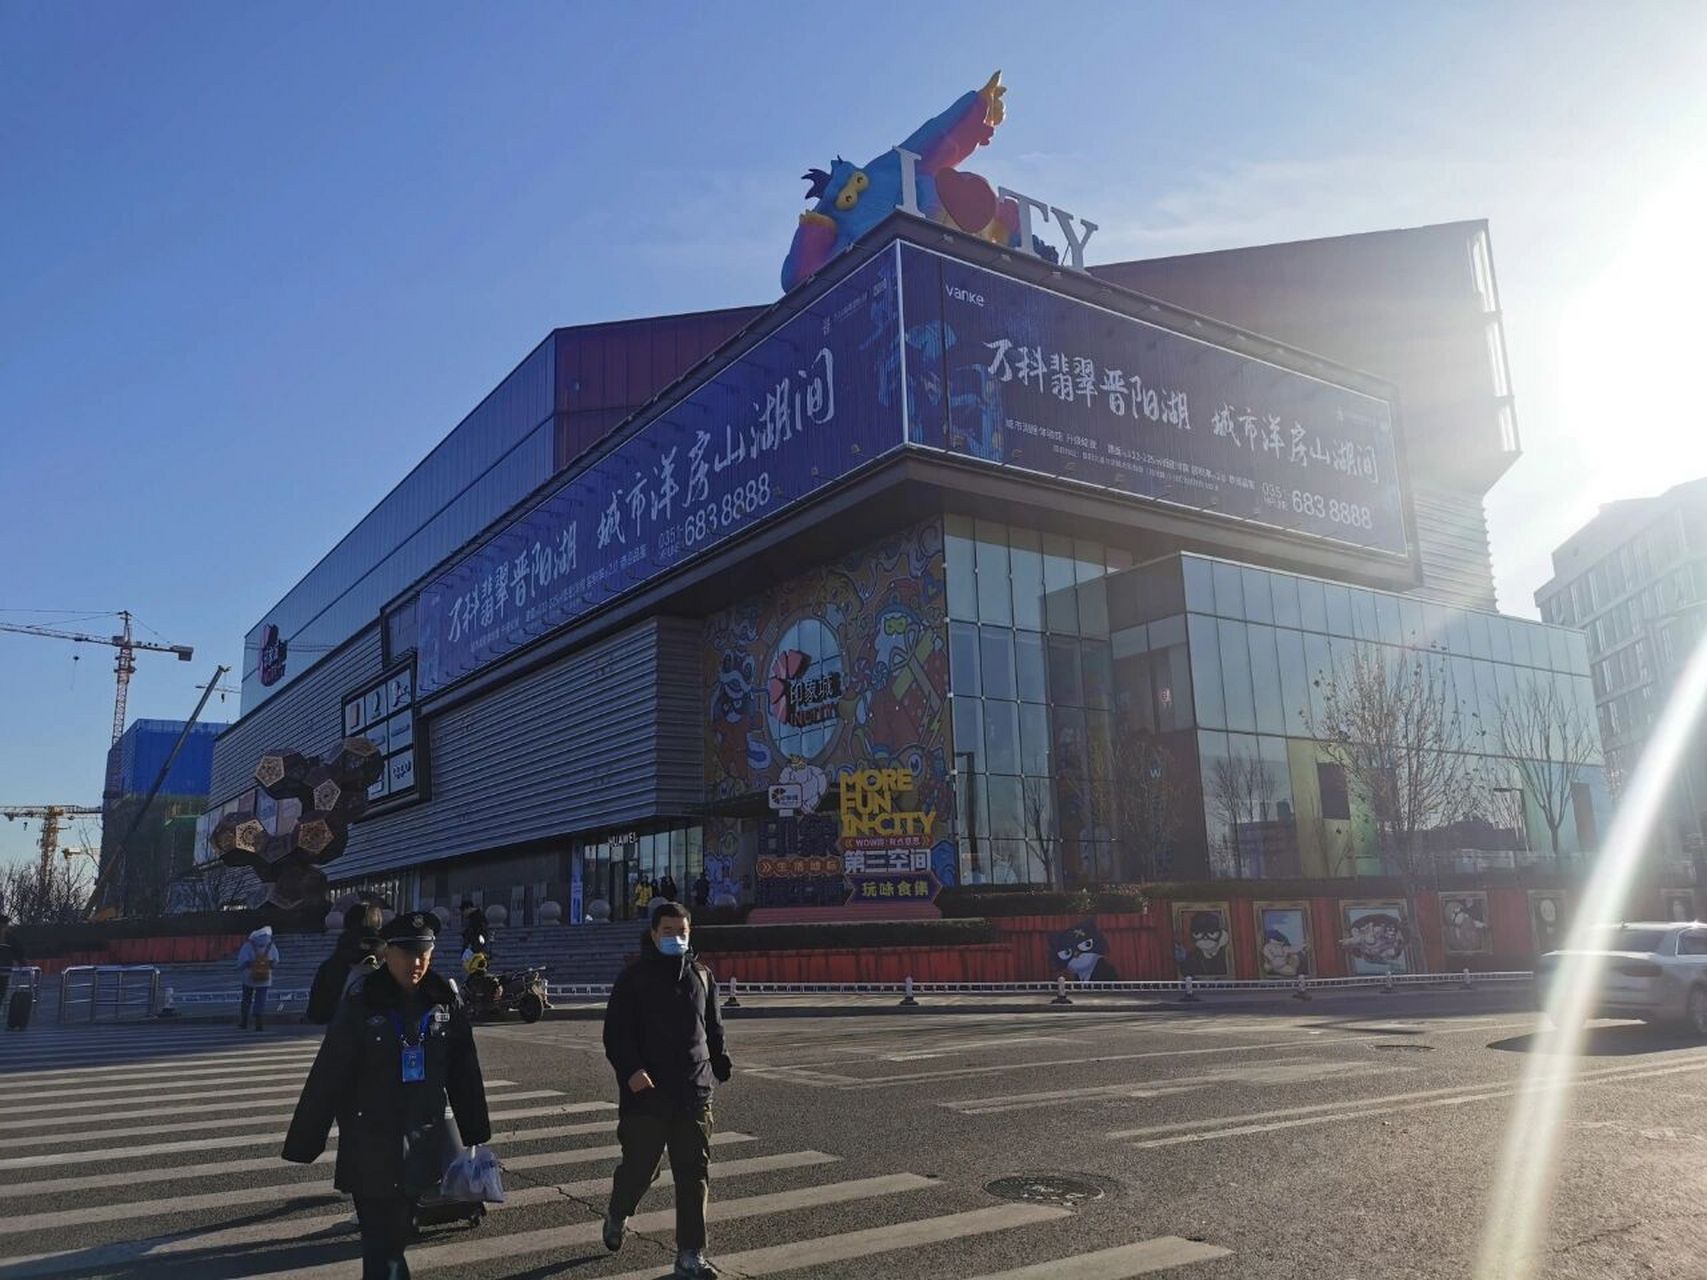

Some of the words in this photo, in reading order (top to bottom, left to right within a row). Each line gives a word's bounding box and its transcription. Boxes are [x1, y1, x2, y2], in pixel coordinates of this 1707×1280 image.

[892, 146, 926, 219] I
[997, 185, 1098, 274] TY
[945, 284, 984, 307] vanke
[982, 338, 1191, 430] 万科翡翠晋阳湖
[1211, 402, 1379, 485] 城市洋房山湖间
[448, 520, 577, 642] 万科翡翠晋阳湖
[597, 346, 835, 550] 城市洋房山湖间
[685, 502, 717, 546] 683
[721, 472, 771, 526] 8888
[1292, 490, 1325, 518] 683
[1329, 499, 1372, 529] 8888
[840, 768, 913, 793] MORE
[840, 790, 892, 815] FUN
[844, 849, 931, 873] 第三空间
